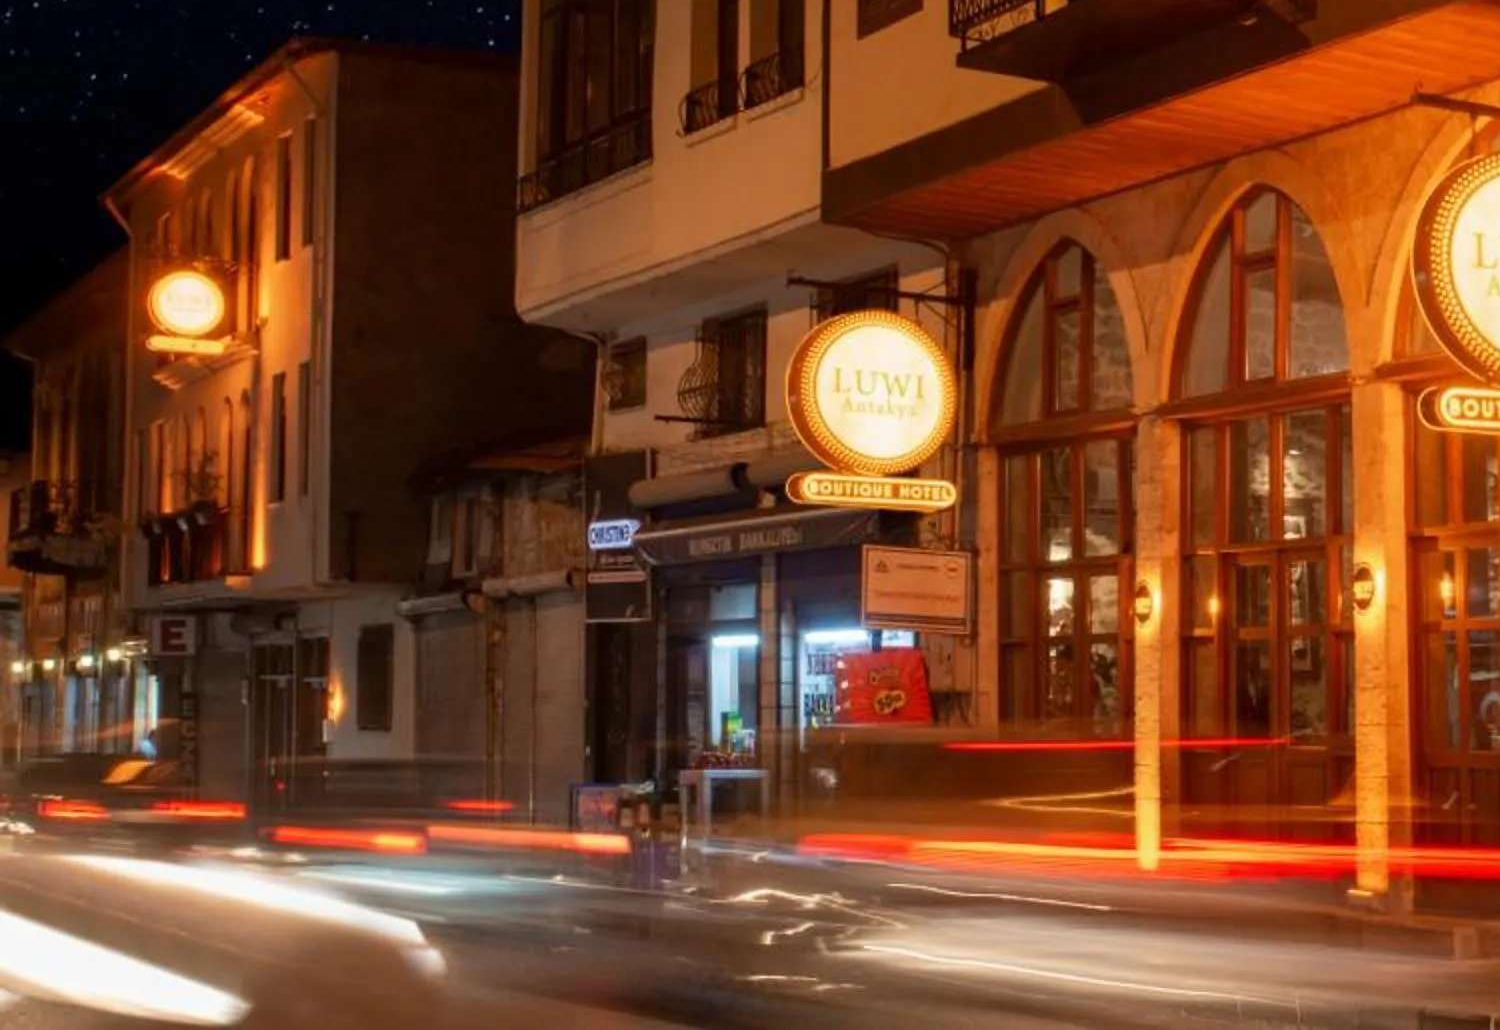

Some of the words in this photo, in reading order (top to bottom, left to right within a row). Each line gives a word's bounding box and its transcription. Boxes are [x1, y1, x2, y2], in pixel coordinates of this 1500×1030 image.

[832, 367, 925, 400] LUWI
[808, 480, 893, 499] BOUTIQUE
[899, 485, 951, 502] HOTEL
[159, 620, 188, 652] E
